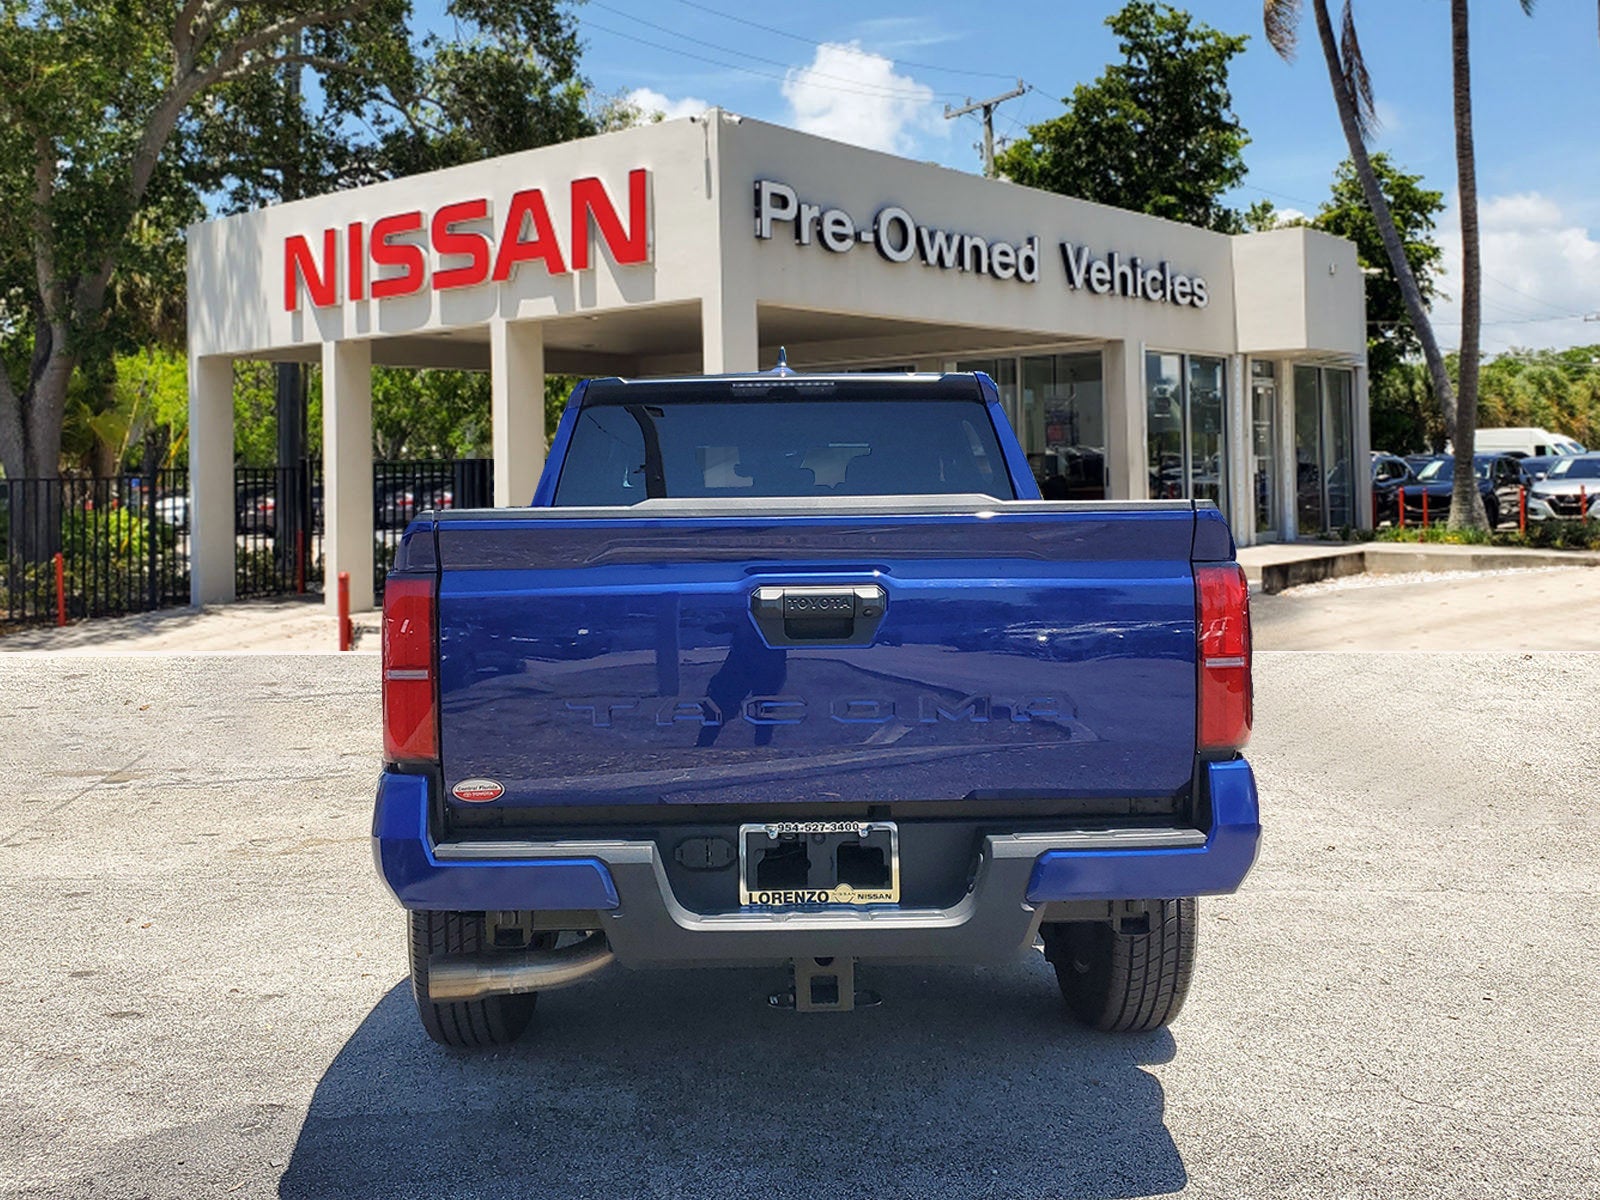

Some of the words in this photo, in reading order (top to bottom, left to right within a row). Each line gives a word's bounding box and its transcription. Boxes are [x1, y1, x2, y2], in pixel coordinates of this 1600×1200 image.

[284, 168, 649, 312] NISSAN
[754, 179, 1040, 284] Pre-Owned
[1060, 240, 1209, 309] Vehicles
[787, 598, 851, 610] TOYOTA
[565, 693, 1078, 727] TACOMA
[777, 823, 859, 832] 954-527-3400
[749, 891, 829, 905] LORENZO
